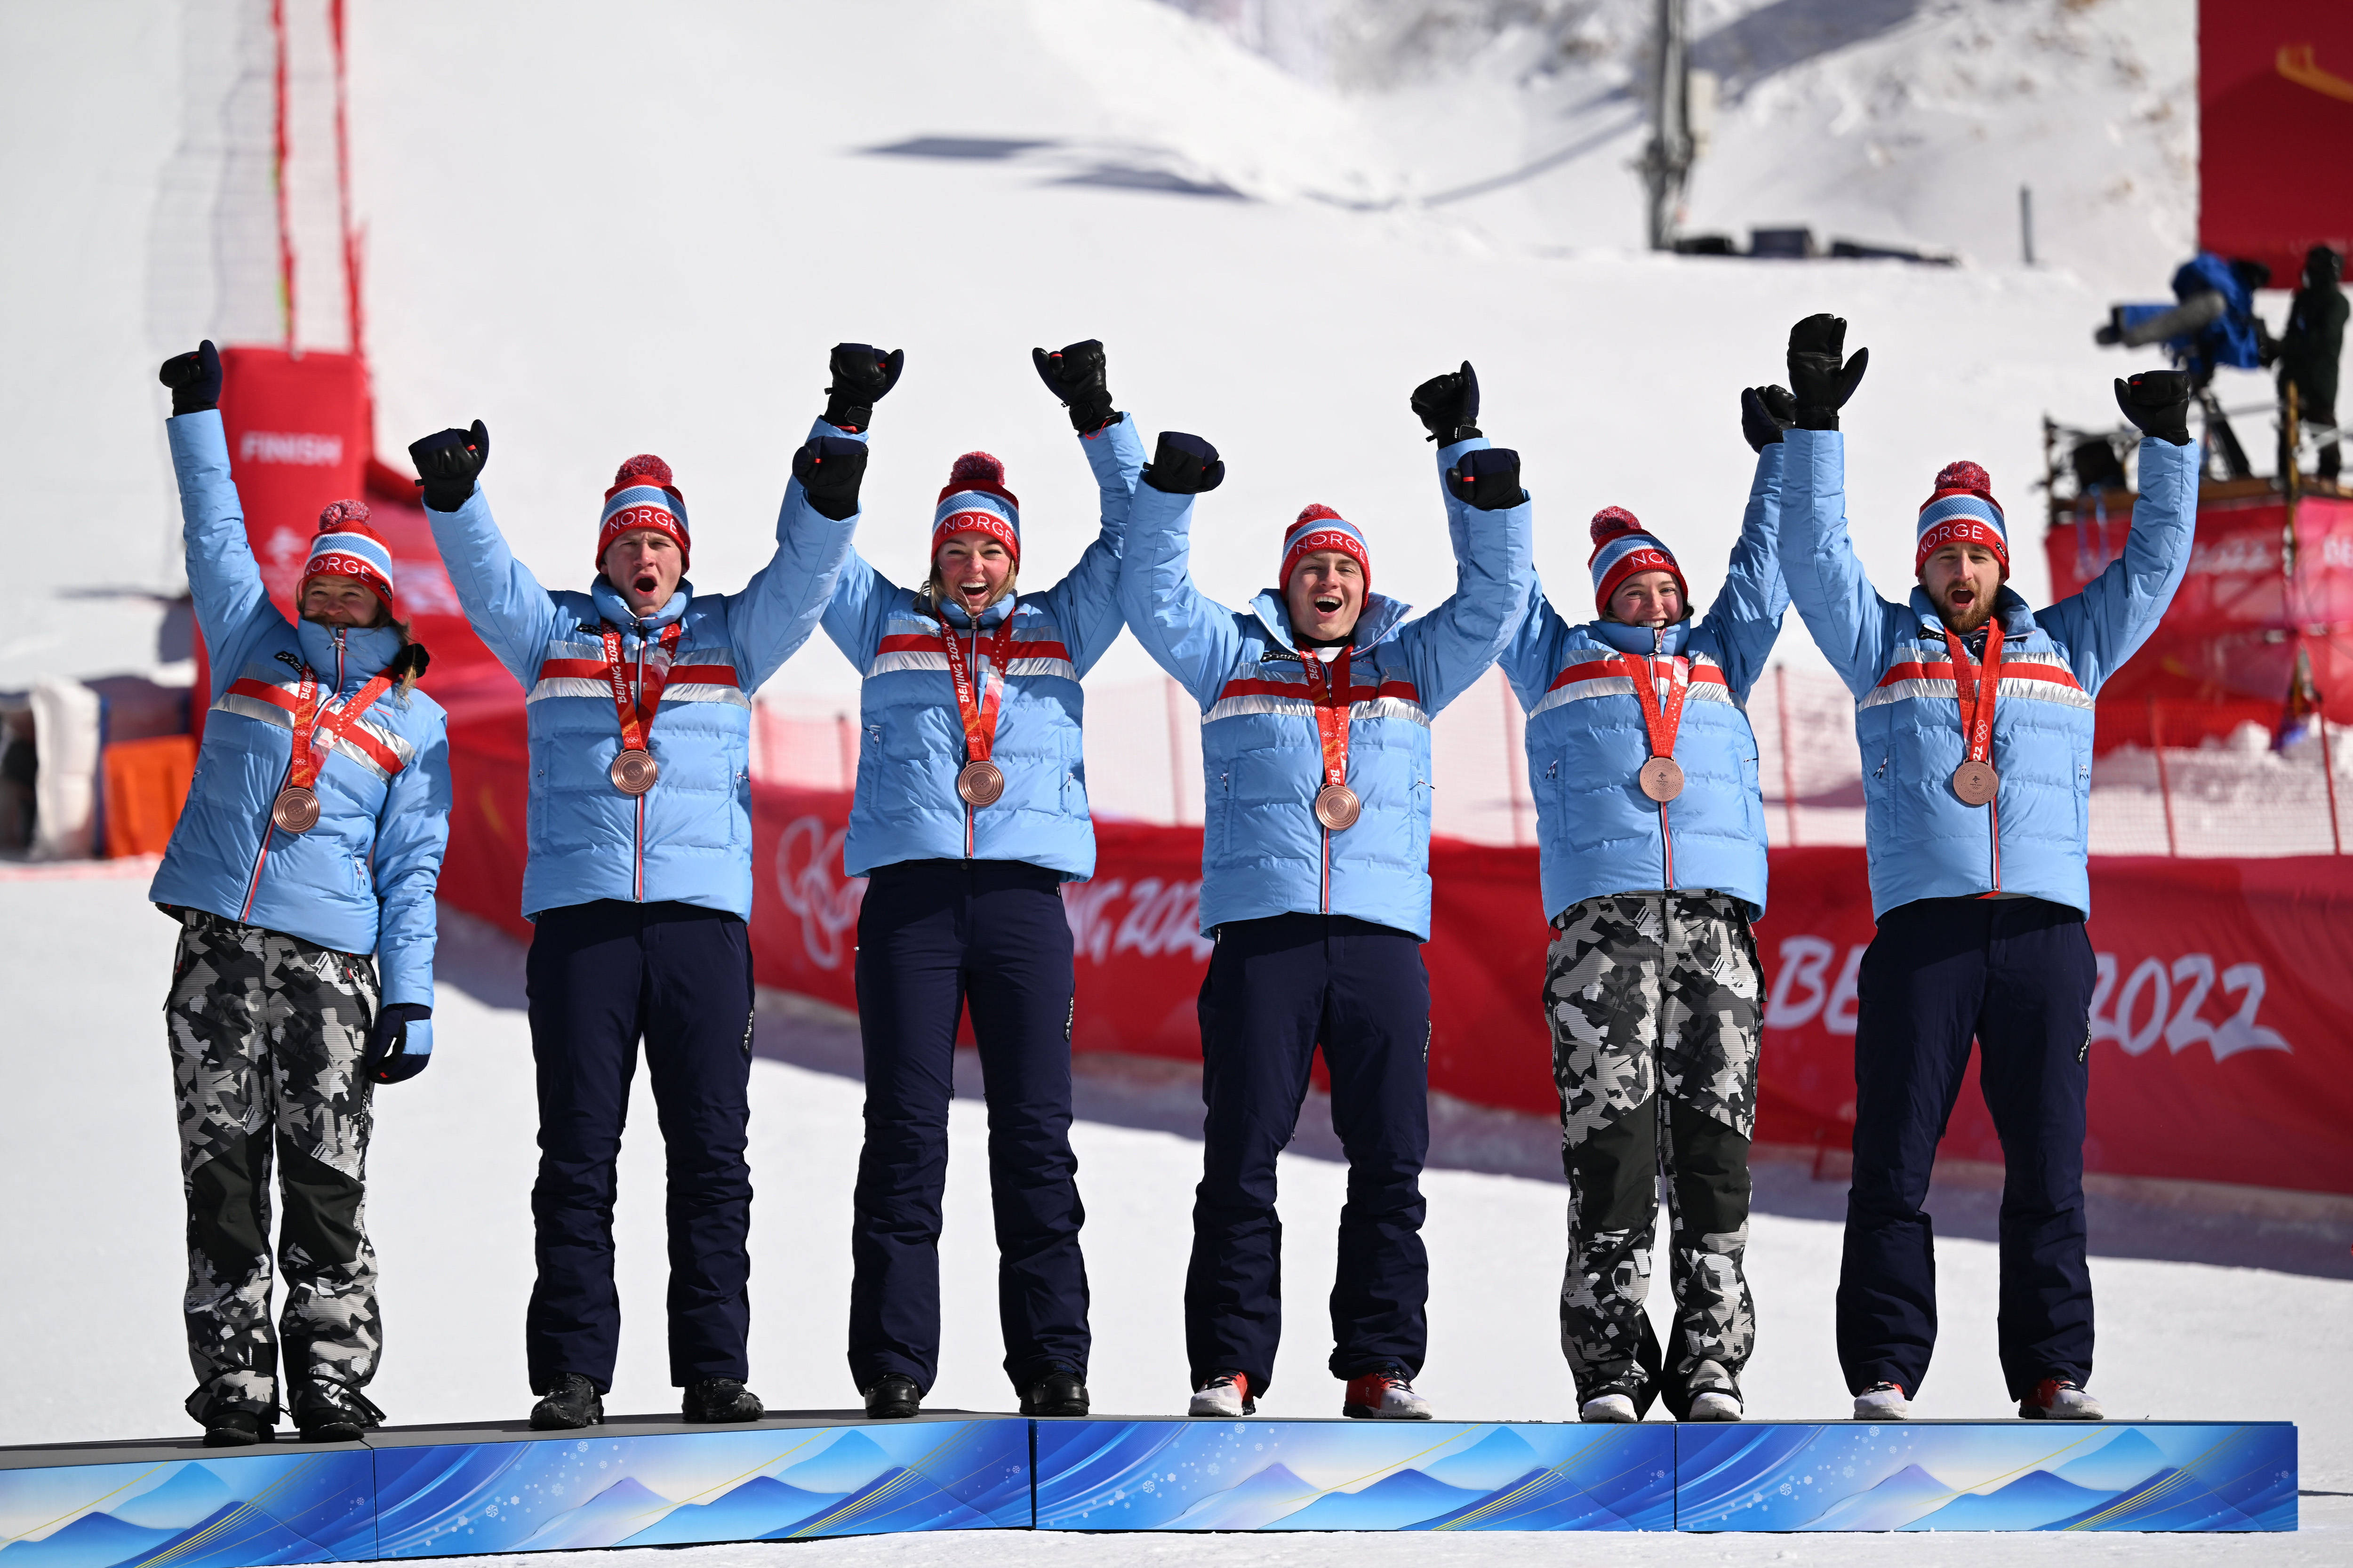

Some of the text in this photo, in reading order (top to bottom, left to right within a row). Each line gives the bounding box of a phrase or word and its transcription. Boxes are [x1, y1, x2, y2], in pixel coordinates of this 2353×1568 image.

[239, 430, 344, 467] FINISH
[609, 510, 678, 535] NORGE
[944, 515, 1012, 546] NORGE
[1297, 534, 1367, 564] NORGE
[1921, 524, 1984, 557] NORGE
[1631, 552, 1677, 568] NOR
[607, 639, 627, 704] BEIJING 2022
[946, 634, 970, 704] BEIJING 2022
[1302, 651, 1319, 680] BEIJING
[300, 671, 315, 700] BEIJING
[1973, 745, 1983, 761] 22
[1113, 876, 1216, 963] 202
[2090, 951, 2295, 1064] 2022
